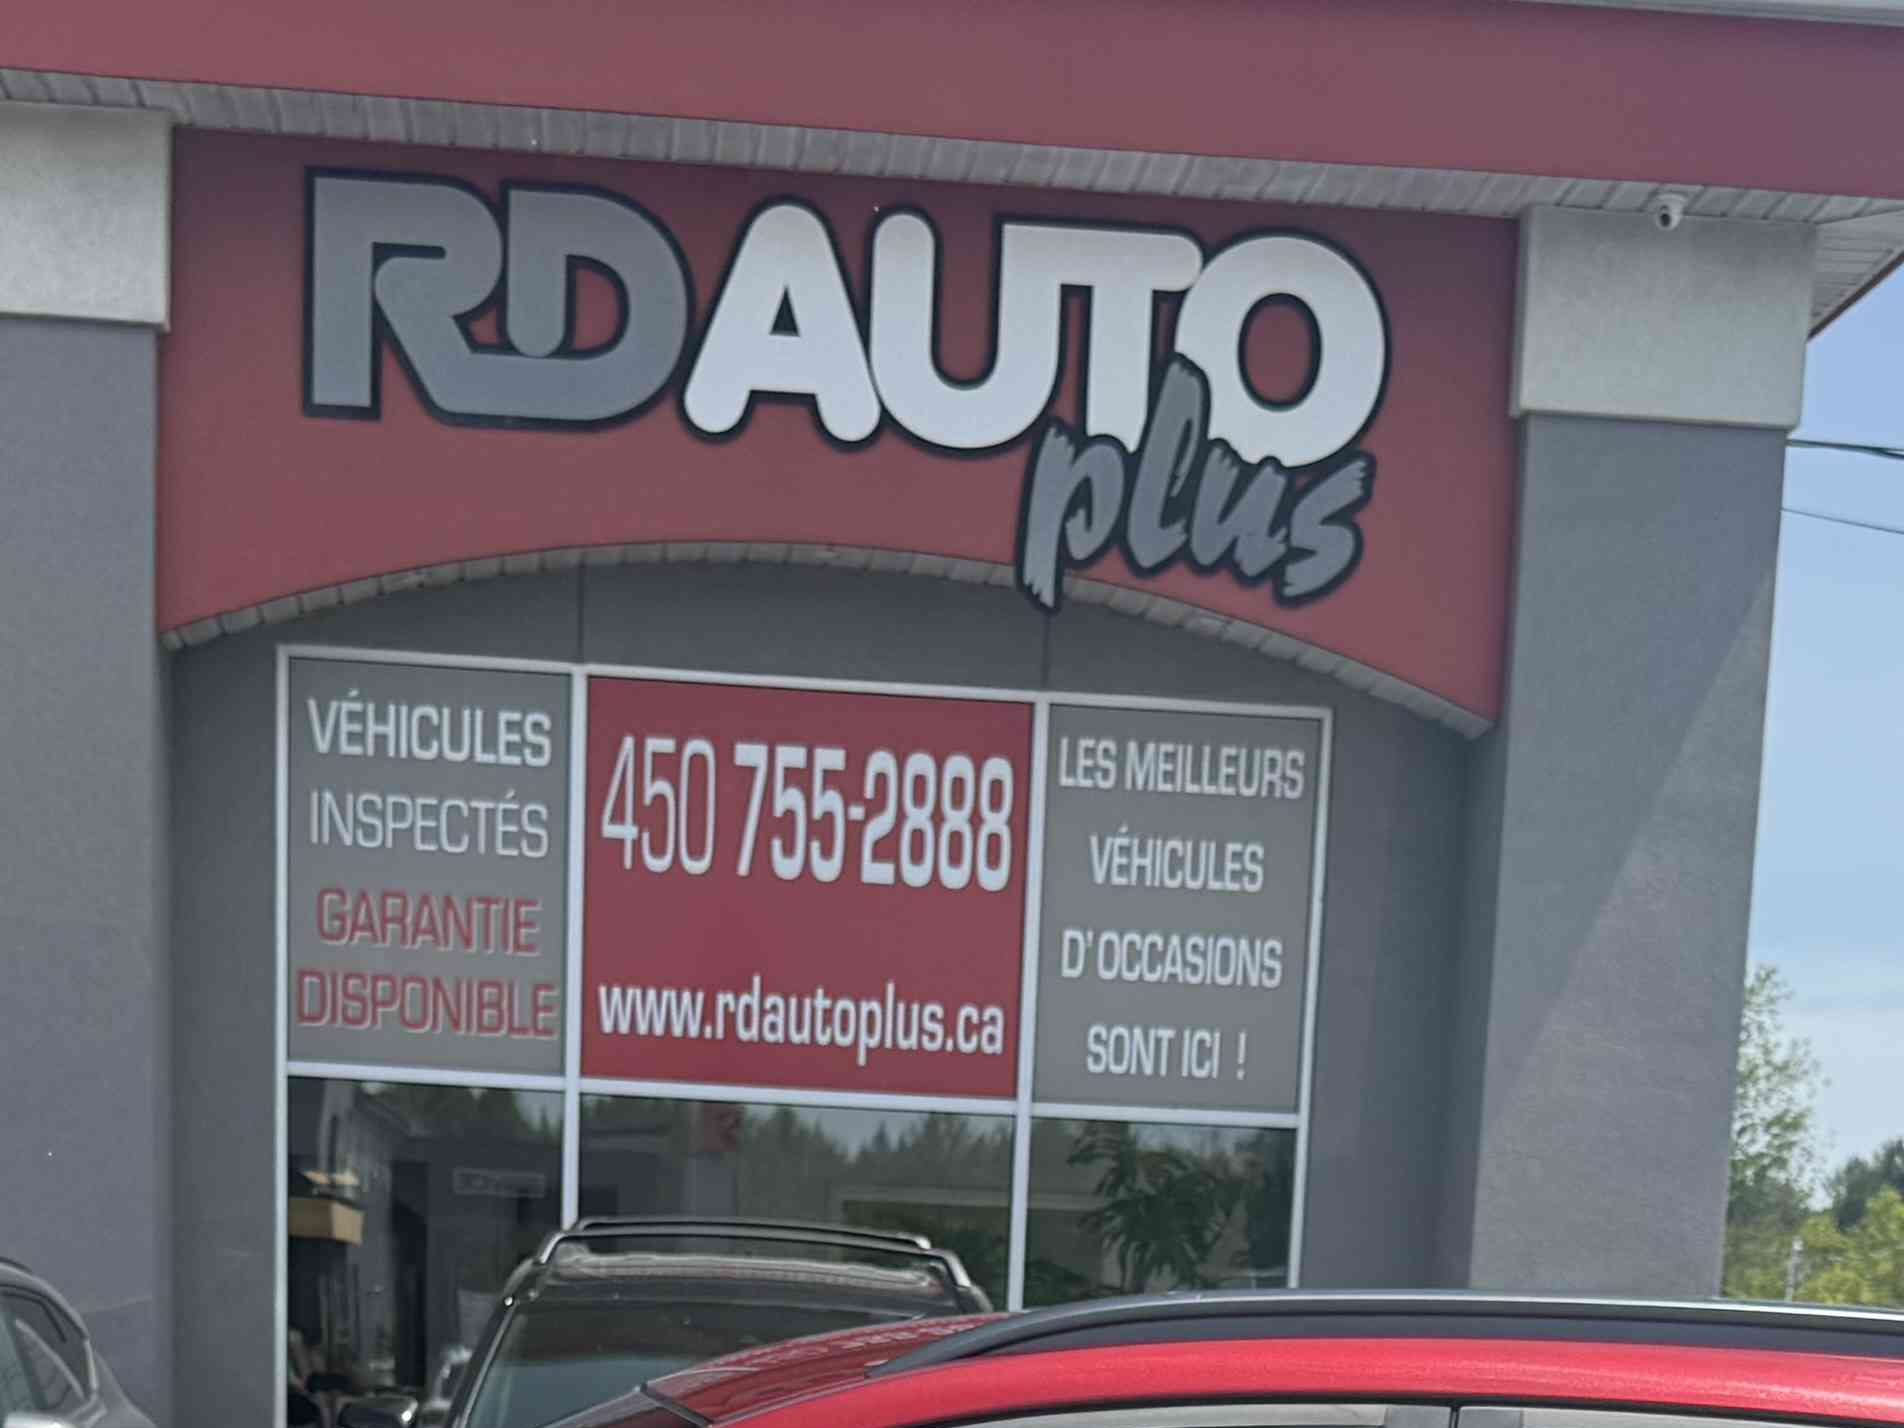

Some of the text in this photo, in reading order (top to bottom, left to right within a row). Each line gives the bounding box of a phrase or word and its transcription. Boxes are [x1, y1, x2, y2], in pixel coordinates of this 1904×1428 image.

[1022, 355, 1370, 606] plus
[306, 689, 552, 767] VÉHICULES
[1058, 736, 1305, 799] LES MEILLEURS
[310, 788, 550, 858] INSPECTÉS
[600, 735, 1014, 892] 450 755-2888
[1089, 822, 1264, 893] VÉHICULES
[317, 885, 542, 958] GARANTIE
[297, 968, 559, 1041] DISPONIBLE
[598, 975, 1004, 1064] www.rdautoplus.ca
[1086, 1023, 1175, 1077] SONT
[1181, 1028, 1221, 1080] ICI
